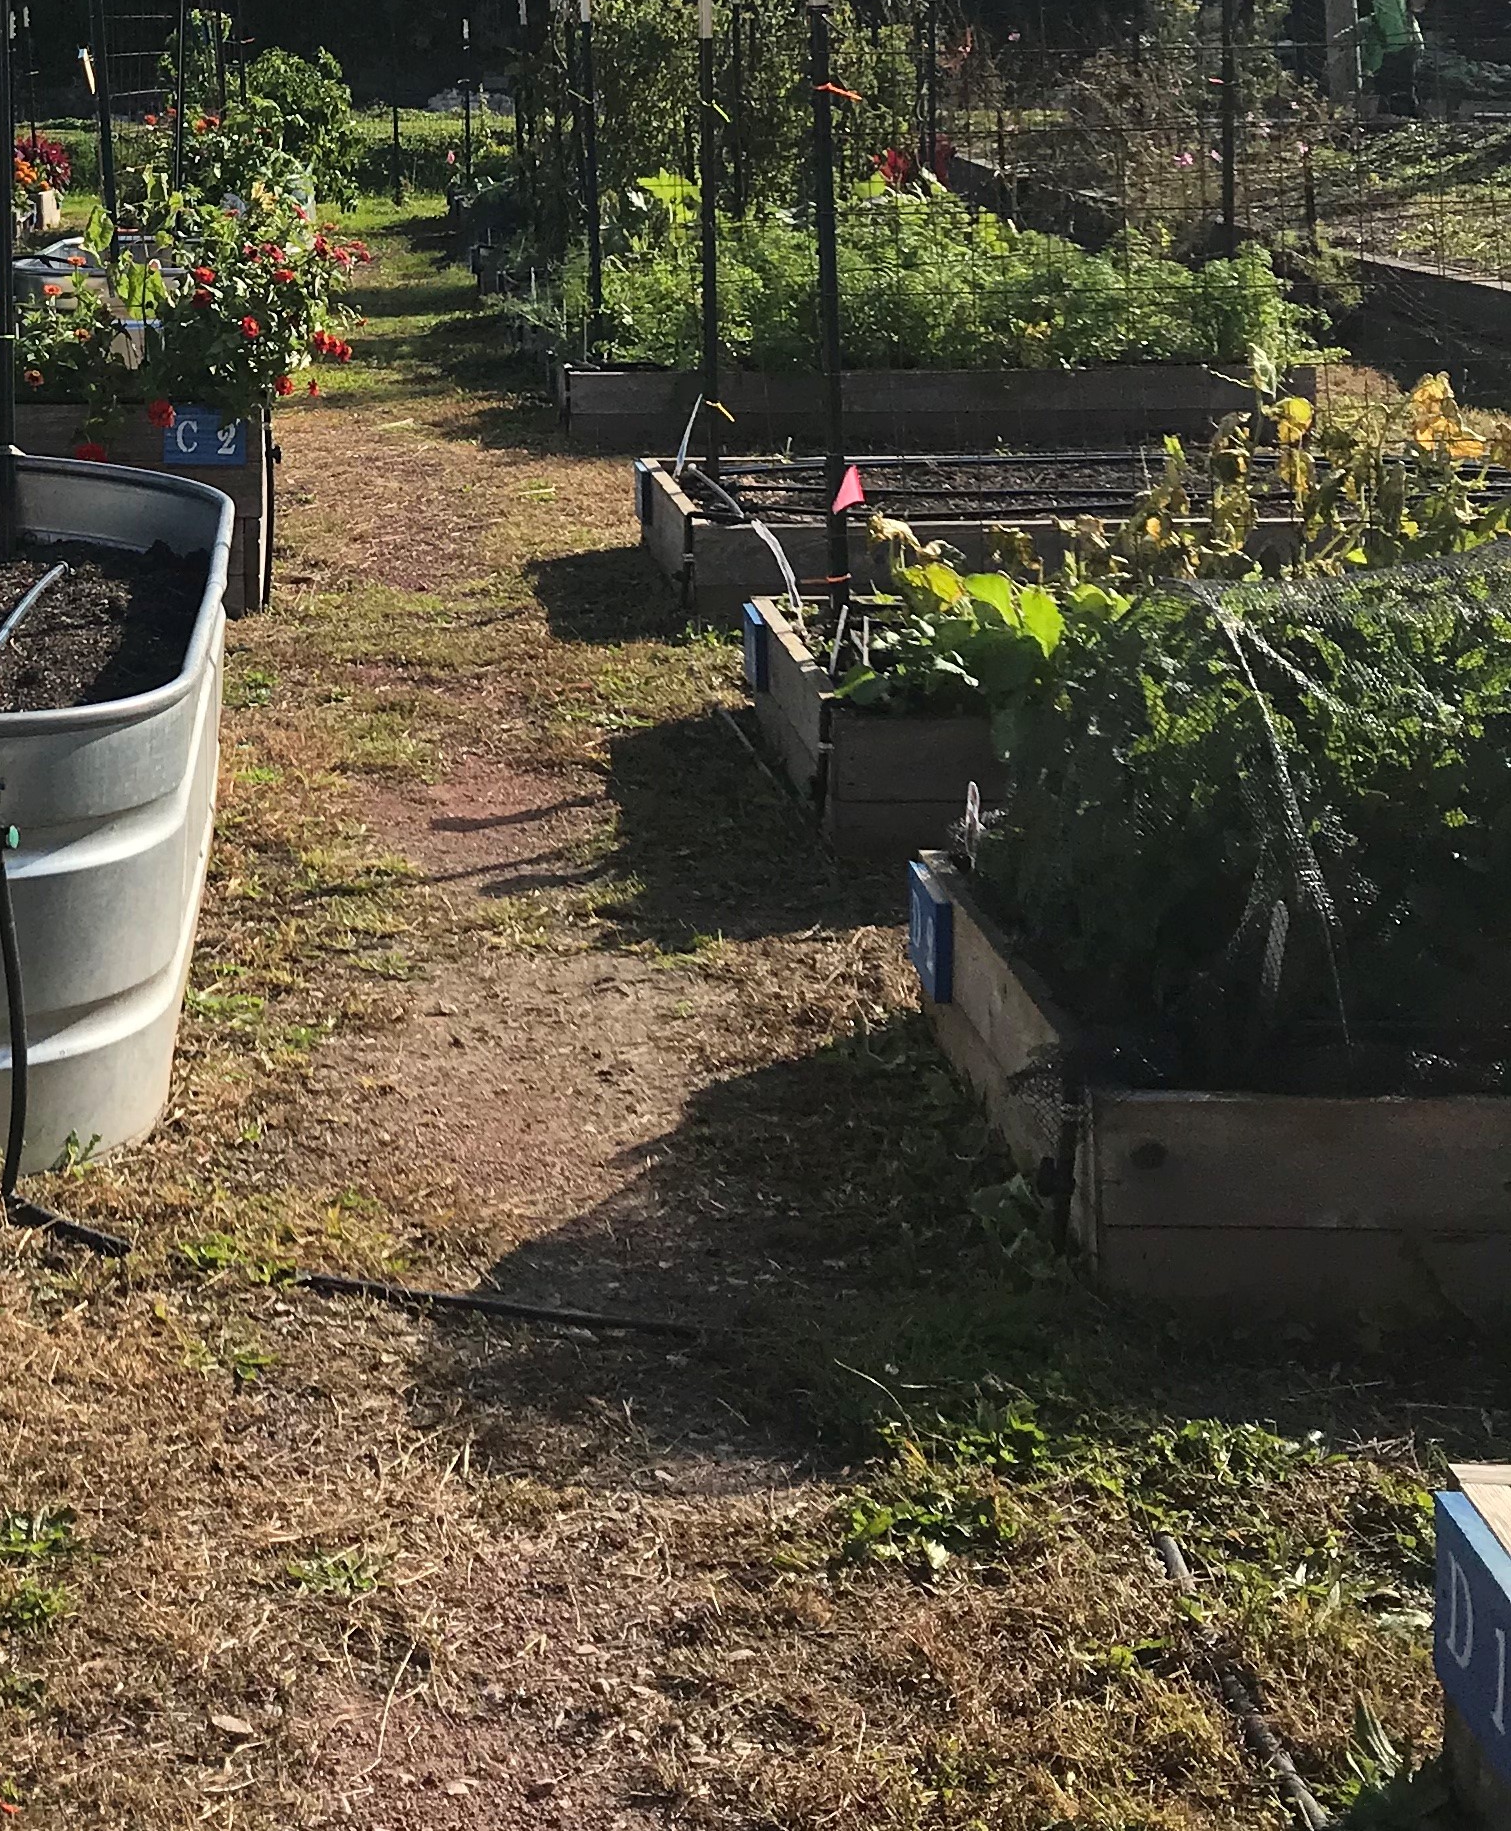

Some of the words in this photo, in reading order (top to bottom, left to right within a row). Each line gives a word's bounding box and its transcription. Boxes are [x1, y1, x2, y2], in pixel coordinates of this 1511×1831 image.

[176, 420, 198, 454] C
[217, 424, 237, 456] 2
[1445, 1550, 1474, 1671] D
